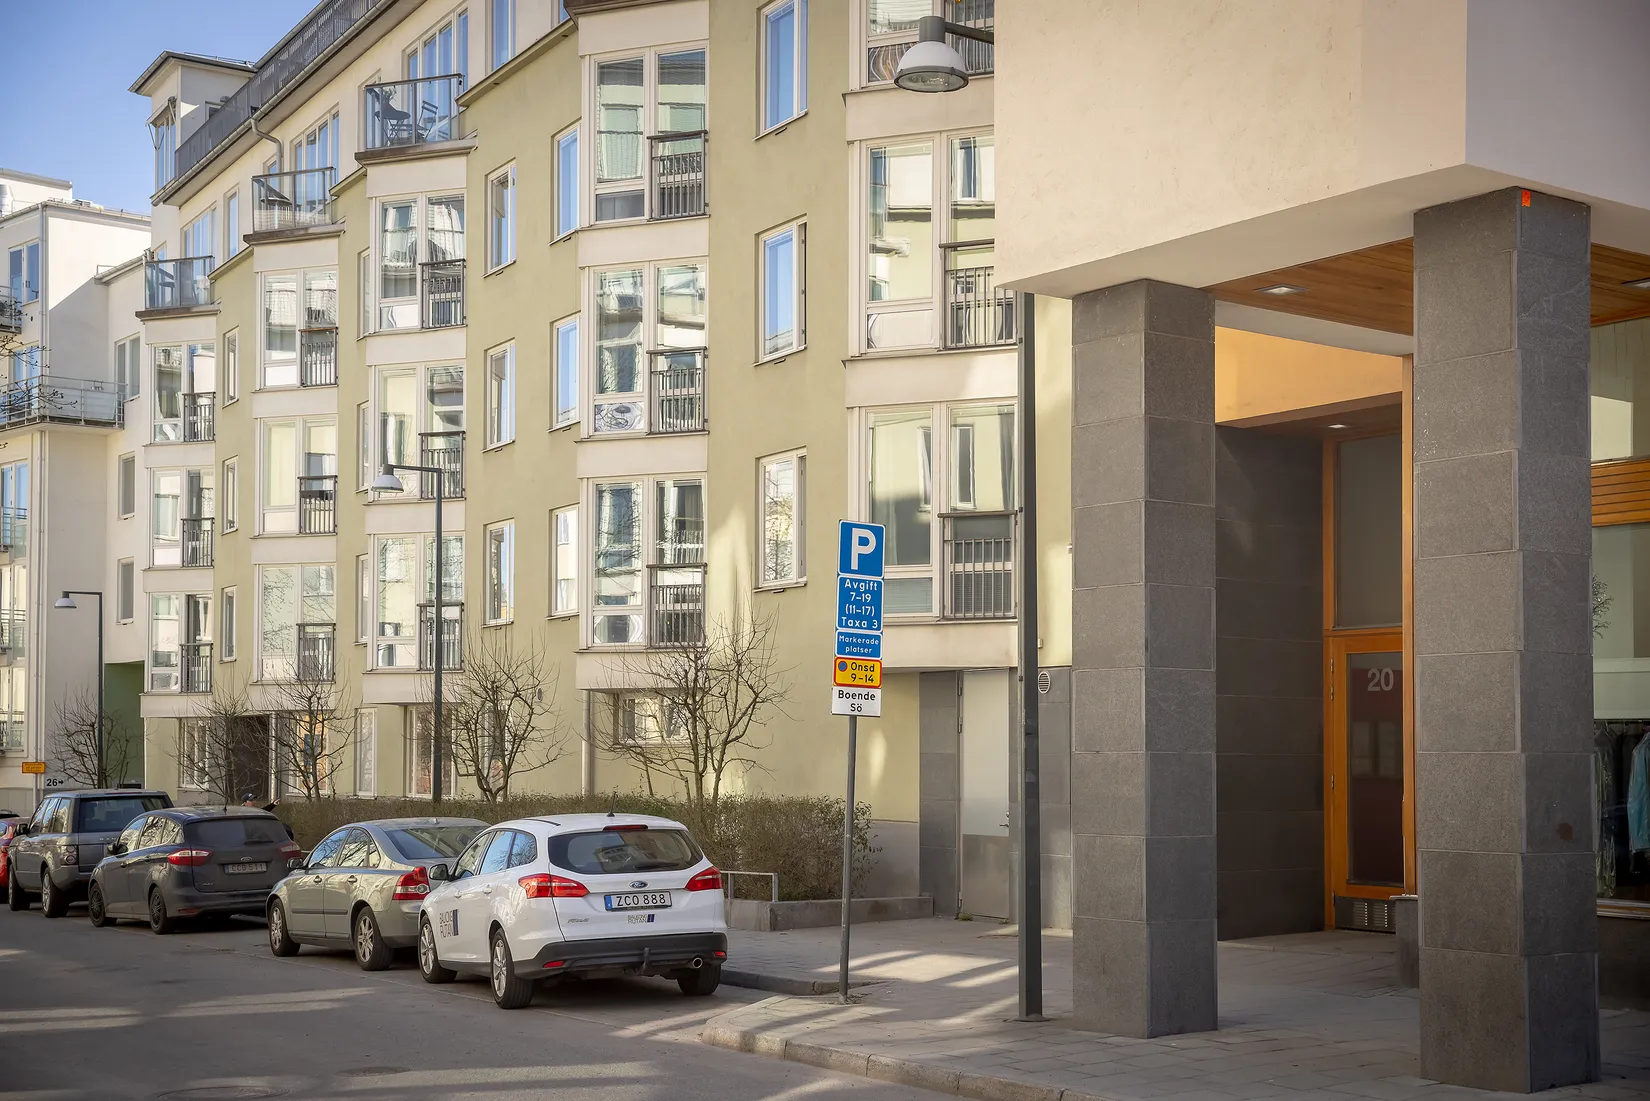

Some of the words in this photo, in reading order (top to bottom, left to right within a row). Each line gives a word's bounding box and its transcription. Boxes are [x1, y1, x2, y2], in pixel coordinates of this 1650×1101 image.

[851, 527, 877, 570] P
[844, 579, 878, 592] Avgift
[849, 592, 872, 603] 7-19
[845, 604, 875, 617] (11-17)
[841, 617, 868, 628] Taxa
[871, 619, 878, 629] 3
[838, 635, 880, 645] Markerade
[845, 646, 873, 654] platser
[850, 662, 875, 673] Onsd
[1367, 667, 1394, 692] 20
[838, 690, 876, 701] Boende
[850, 703, 863, 713] Sö
[46, 778, 58, 787] 26
[615, 895, 640, 907] ZCO
[642, 893, 666, 905] 888
